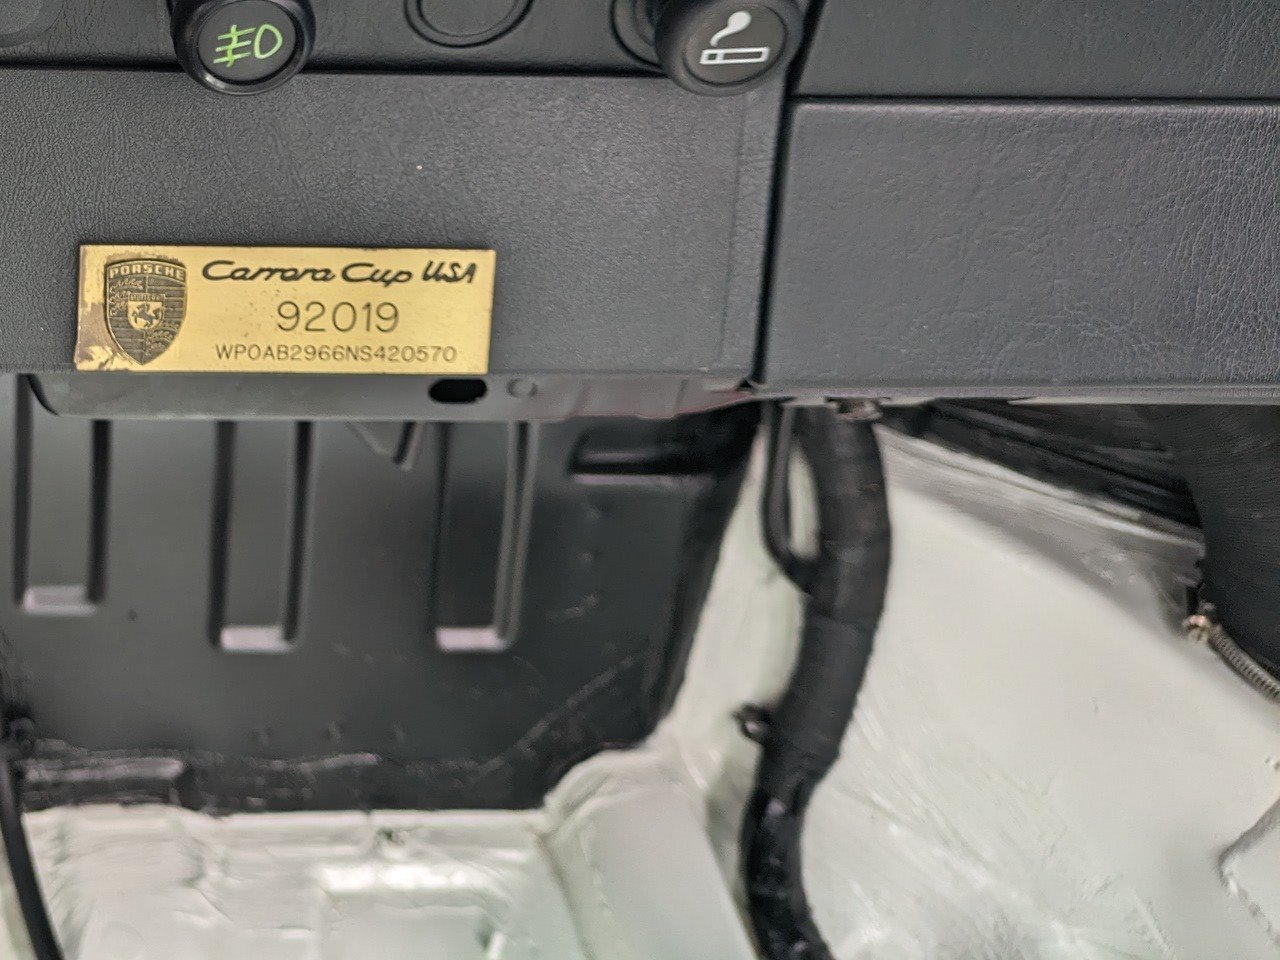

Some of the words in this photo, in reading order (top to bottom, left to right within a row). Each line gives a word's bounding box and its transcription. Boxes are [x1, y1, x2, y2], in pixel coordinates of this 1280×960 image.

[109, 263, 185, 281] PORSCHE
[341, 262, 414, 287] Cup
[421, 260, 477, 284] USA
[276, 300, 400, 333] 92019
